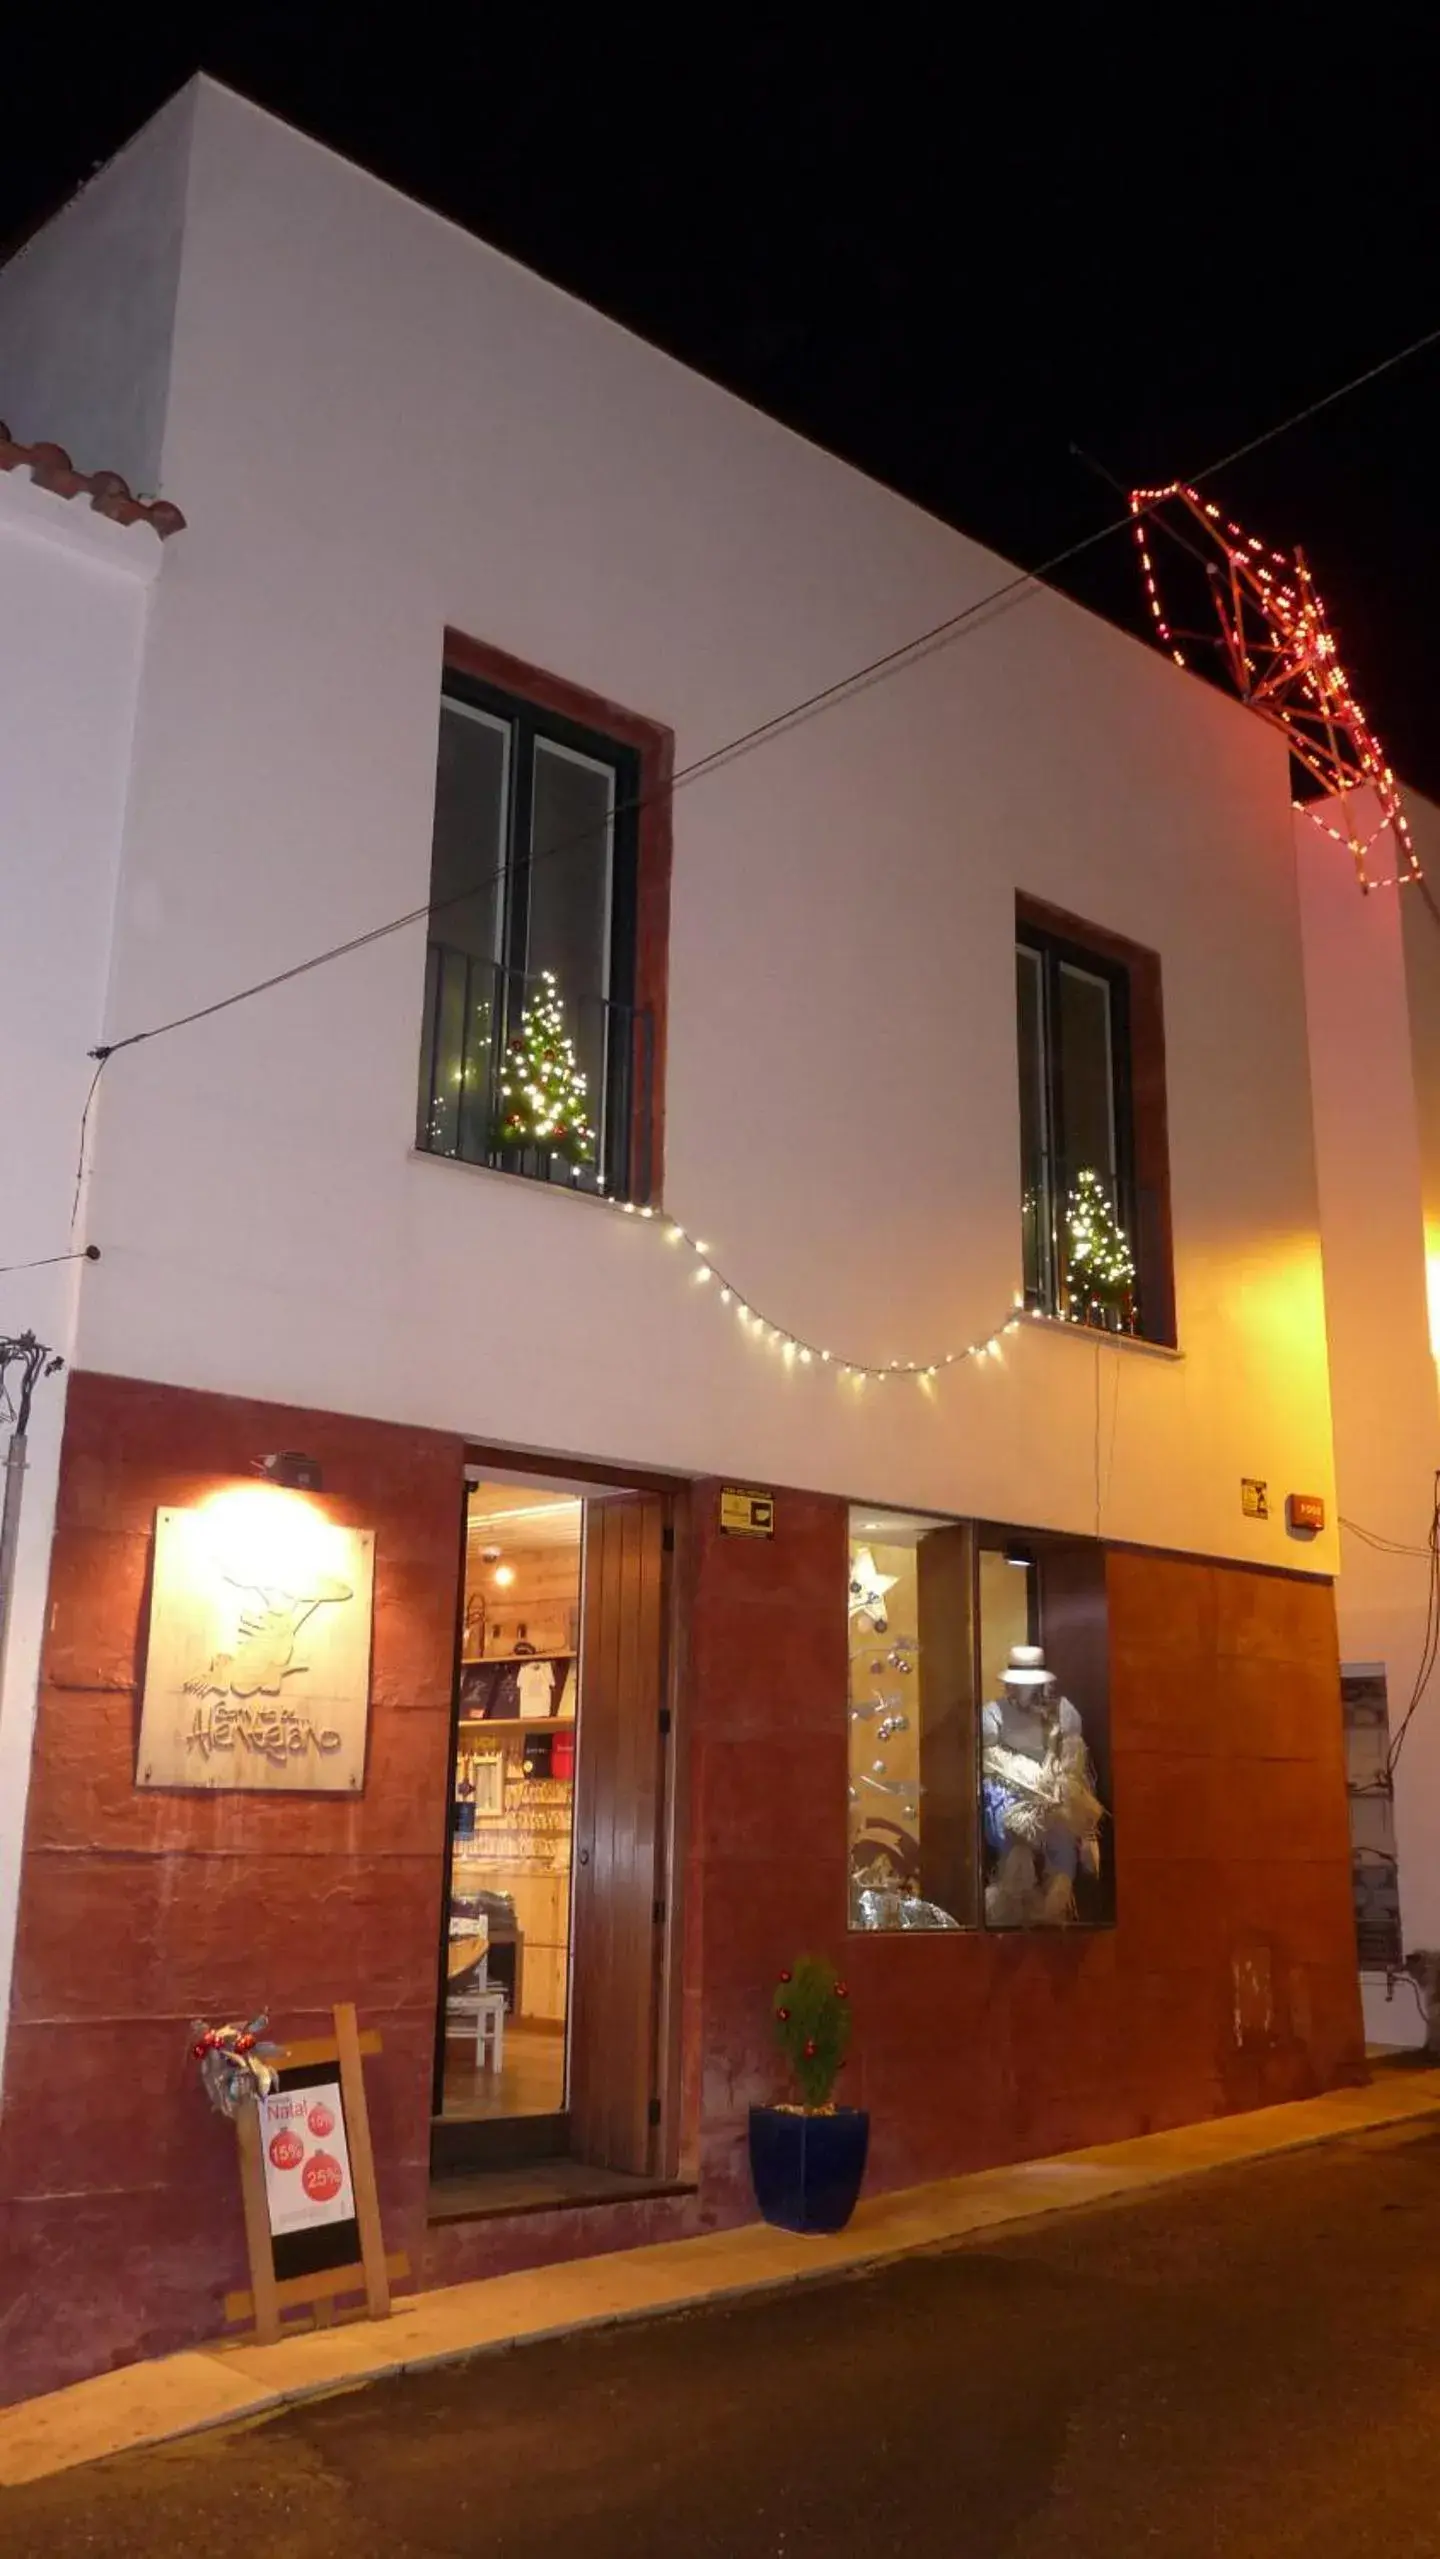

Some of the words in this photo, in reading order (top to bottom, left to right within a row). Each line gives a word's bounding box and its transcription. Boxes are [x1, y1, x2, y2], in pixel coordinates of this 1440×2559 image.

[267, 2098, 308, 2121] Natal
[272, 2143, 303, 2162] 15%
[306, 2167, 341, 2189] 25%
